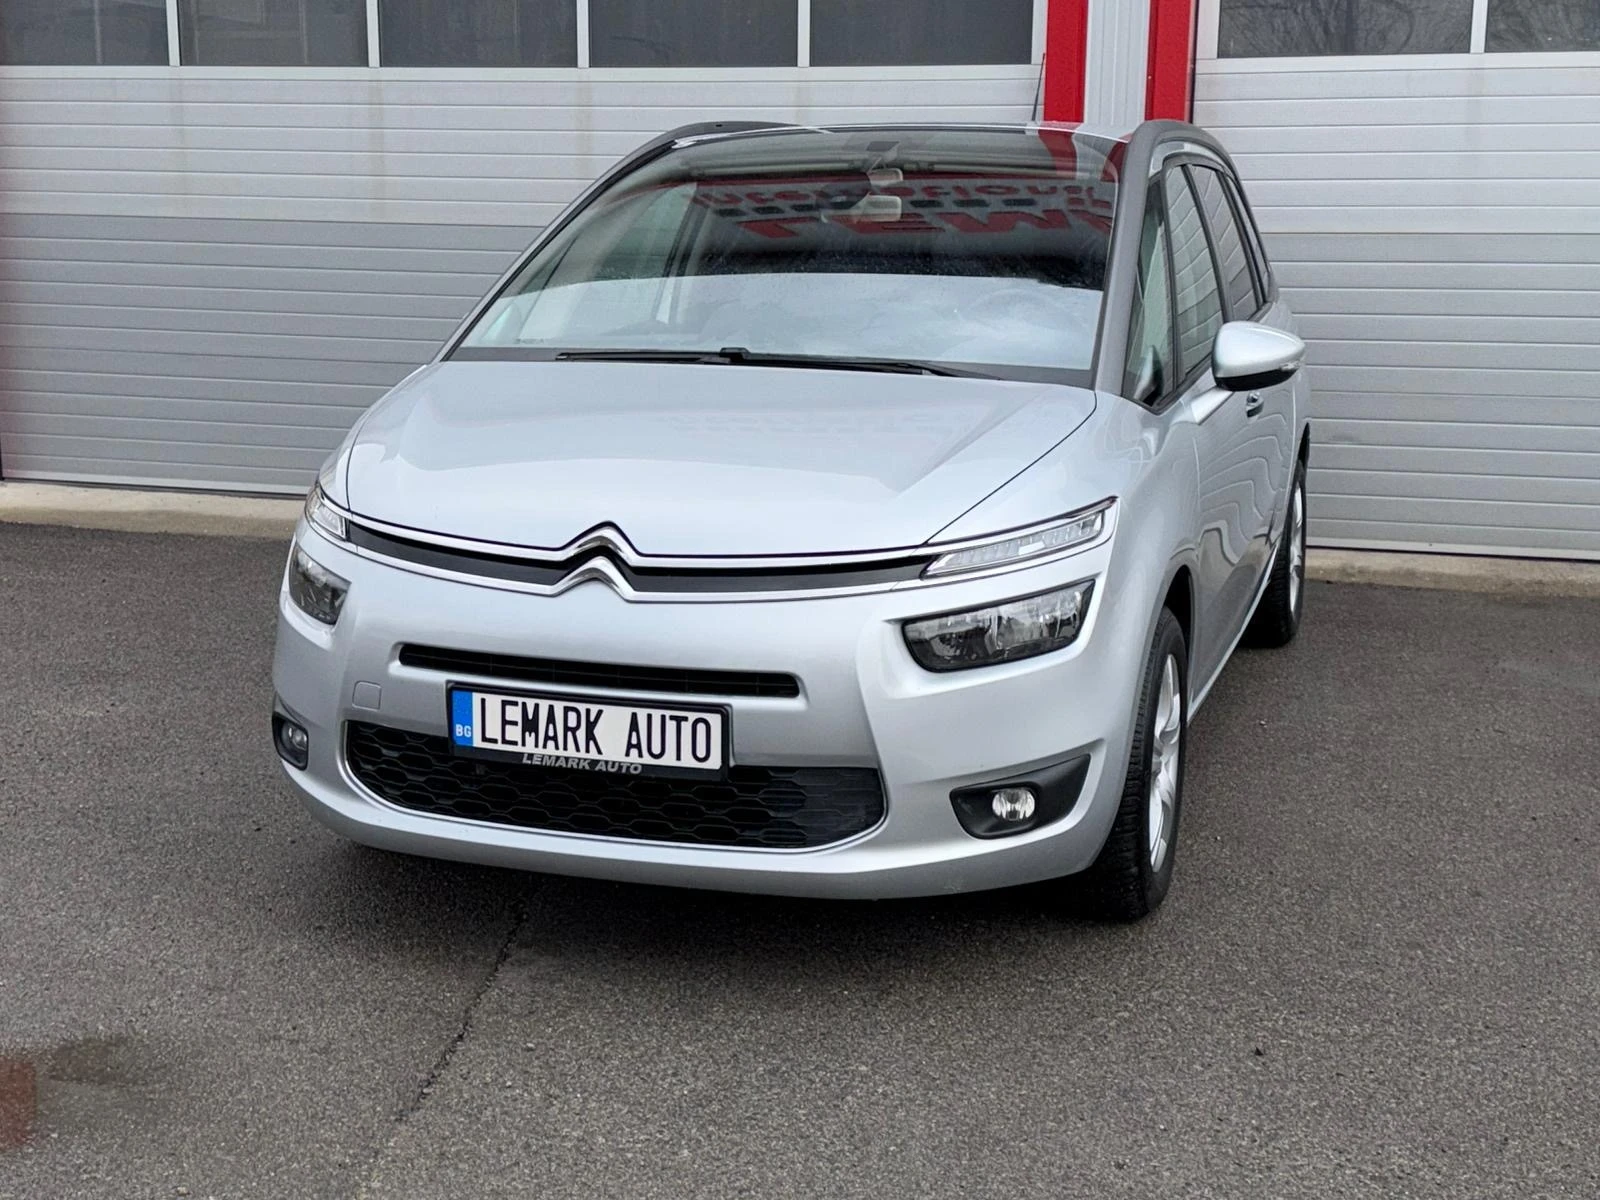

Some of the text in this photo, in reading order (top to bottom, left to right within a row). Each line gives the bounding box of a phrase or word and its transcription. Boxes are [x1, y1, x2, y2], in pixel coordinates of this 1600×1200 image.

[455, 724, 472, 738] BG
[480, 698, 712, 763] LEMARK AUTO
[522, 753, 643, 775] LEMARK AUTO
